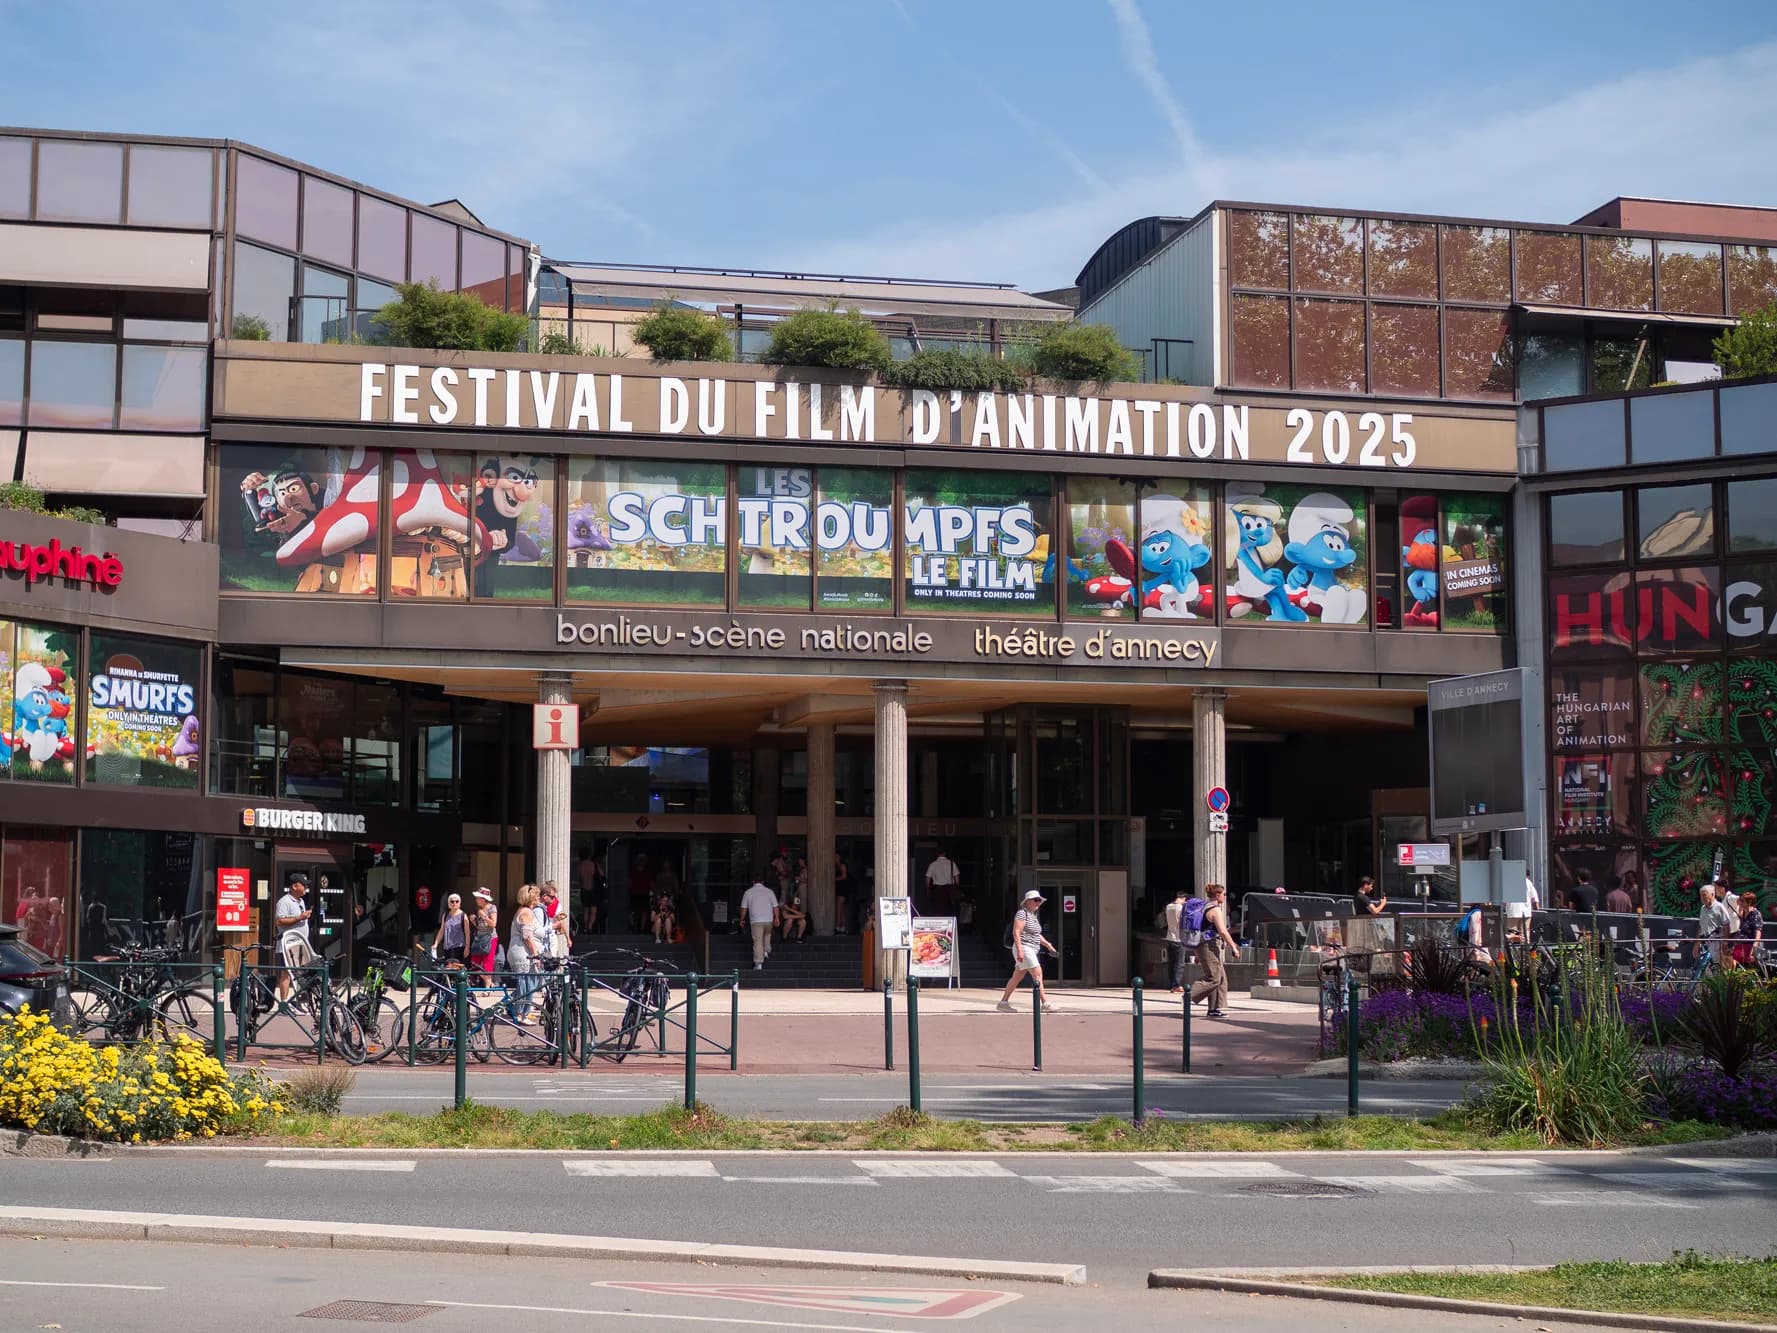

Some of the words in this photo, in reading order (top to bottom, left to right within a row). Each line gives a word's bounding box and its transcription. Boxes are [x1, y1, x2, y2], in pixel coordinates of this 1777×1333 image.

[361, 363, 632, 432] FESTIVAL
[659, 377, 726, 436] DU
[755, 381, 875, 442] FILM
[912, 389, 1250, 461] D'ANIMATION
[1286, 408, 1417, 468] 2025
[756, 468, 811, 498] LES
[608, 491, 1037, 557] SCHTROUMPFS
[911, 554, 949, 588] LE
[959, 556, 1038, 591] FILM
[1446, 570, 1457, 580] IN
[1459, 563, 1498, 578] CINEMAS
[1447, 578, 1478, 591] COMING
[1479, 575, 1501, 586] SOON
[914, 588, 933, 596] ONLY
[935, 589, 943, 597] IN
[945, 589, 982, 598] THEATRES
[983, 591, 1013, 599] COMING
[1014, 592, 1035, 600] SOON
[1556, 581, 1777, 648] HUNG
[557, 614, 786, 650] bonlieu-scène
[801, 623, 933, 653] nationale
[974, 624, 1076, 657] théâtre
[1084, 629, 1218, 668] d'annecy
[109, 667, 137, 677] RIHANNA
[143, 671, 179, 682] SMURFETTE
[92, 674, 194, 715] SMURFS
[1441, 687, 1465, 699] VILLE
[1556, 692, 1579, 702] THE
[1556, 702, 1630, 713] HUNGARIAN
[108, 711, 129, 722] ONLY
[129, 713, 138, 722] IN
[139, 714, 178, 726] THEATRES
[1556, 714, 1578, 724] ART
[1556, 725, 1573, 735] OF
[1556, 734, 1626, 746] ANIMATION
[255, 808, 323, 831] BURGER
[324, 812, 366, 833] KING
[1559, 816, 1611, 828] ANNECY
